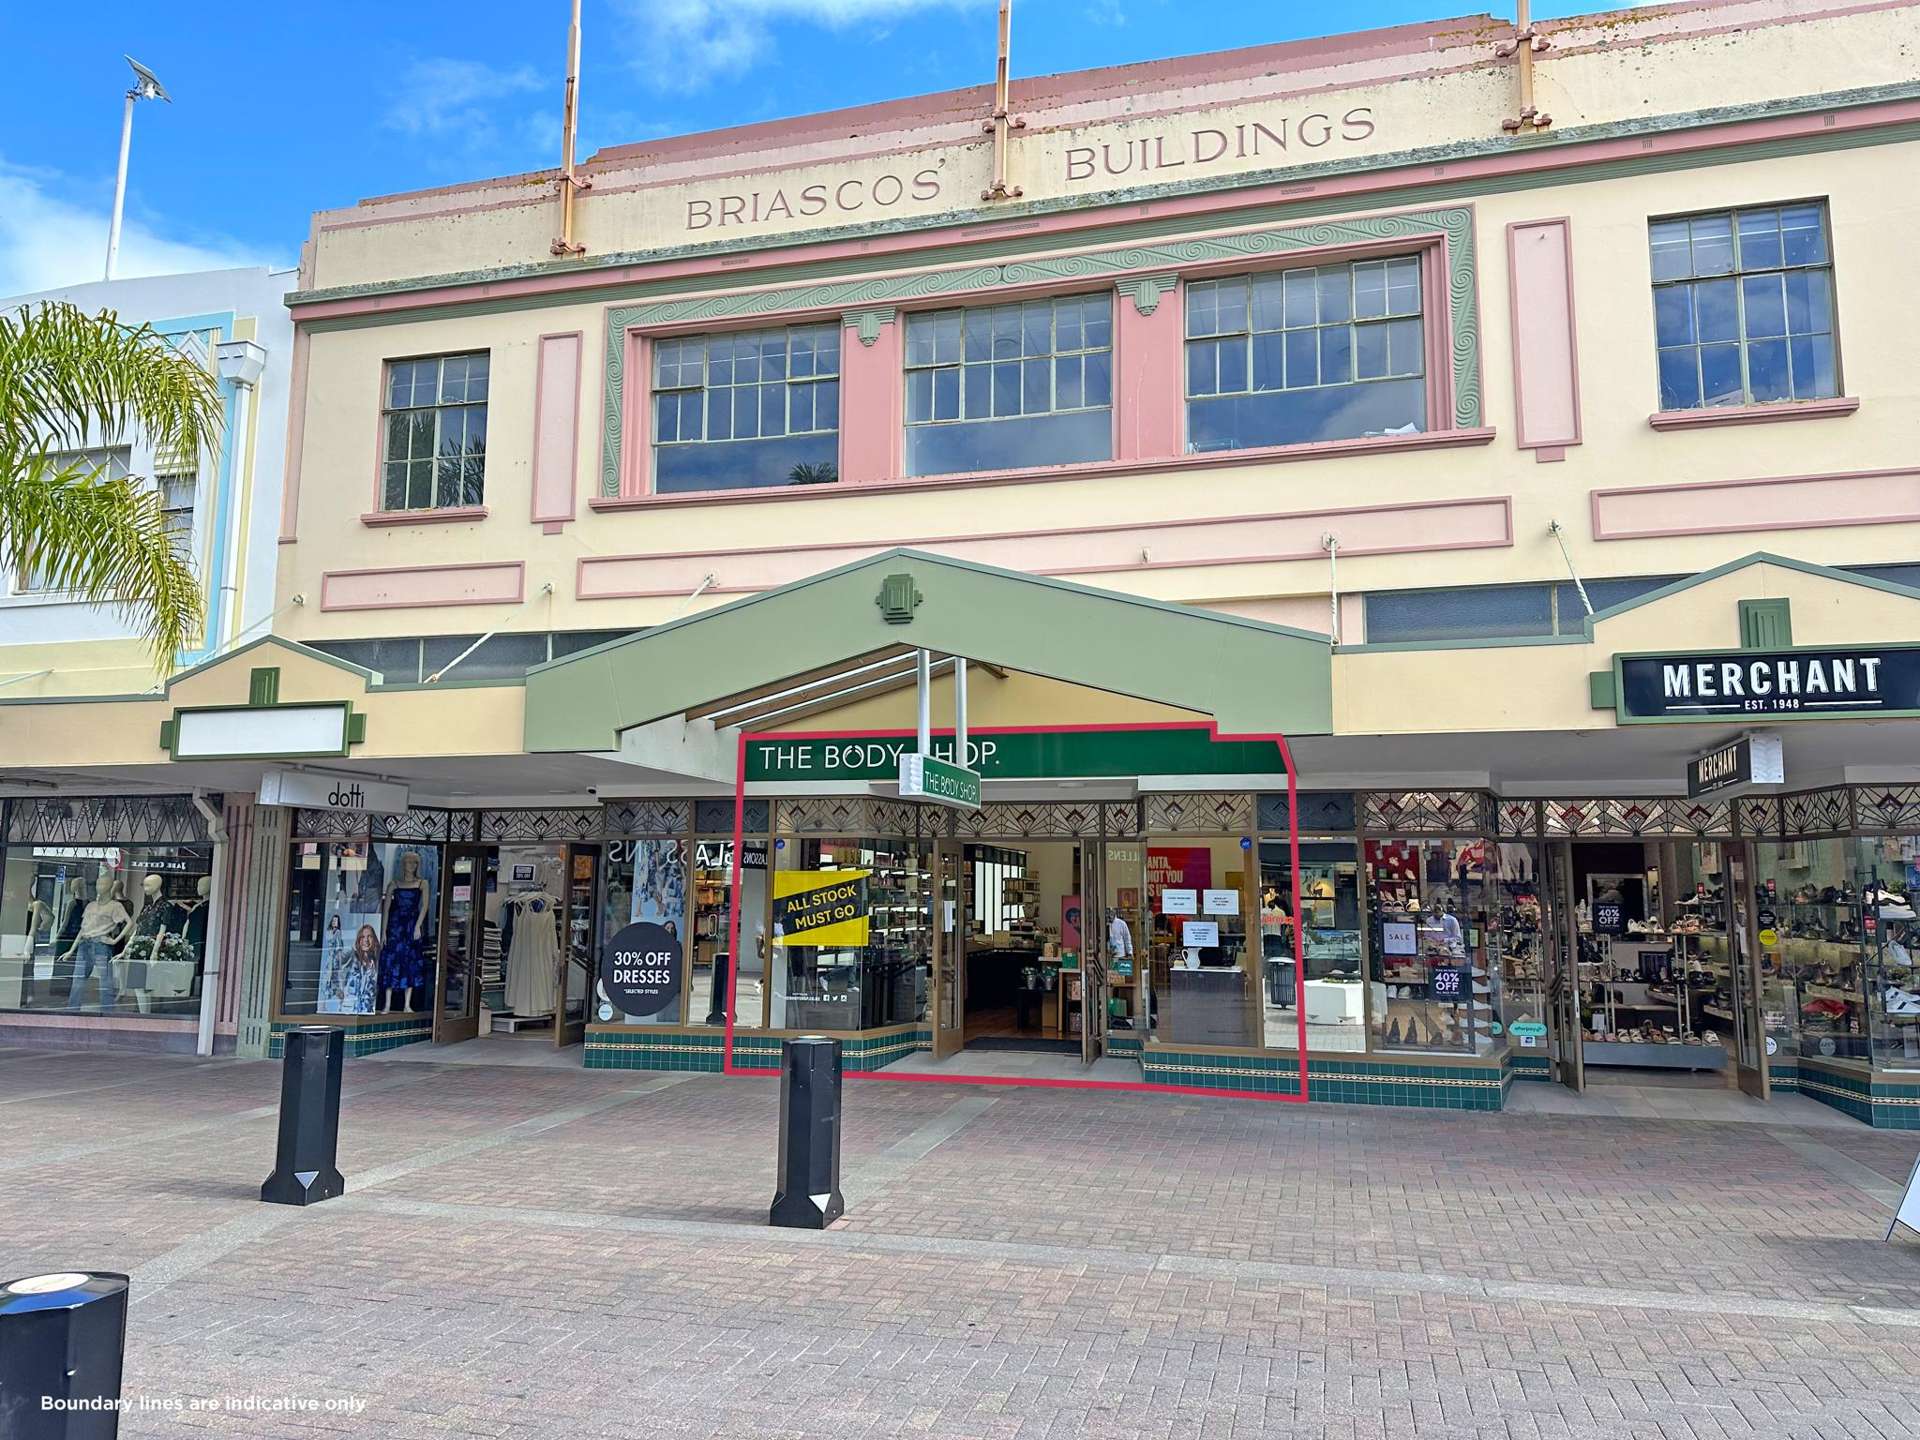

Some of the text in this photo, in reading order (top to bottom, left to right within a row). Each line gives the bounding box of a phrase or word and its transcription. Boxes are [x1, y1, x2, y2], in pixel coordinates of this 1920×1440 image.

[1065, 108, 1375, 182] BUILDINGS
[1663, 658, 1882, 697] MERCHANT
[1745, 699, 1799, 711] EST. 1948
[759, 741, 1000, 770] THE BODY HOP.
[1698, 745, 1737, 784] MERCHANT
[924, 770, 939, 792] THE
[940, 776, 959, 796] BODY
[328, 781, 365, 809] dotti
[1147, 856, 1171, 869] ANTA,
[1165, 870, 1184, 883] YOU
[787, 884, 857, 913] ALL STOCK
[795, 904, 855, 930] MUST GO
[1598, 908, 1620, 917] 40%
[1598, 916, 1620, 925] OFF
[1388, 933, 1410, 941] SALE
[614, 951, 671, 966] 30% OFF
[613, 969, 670, 985] DRESSES
[1434, 972, 1460, 982] 40%
[1435, 982, 1459, 991] OFF
